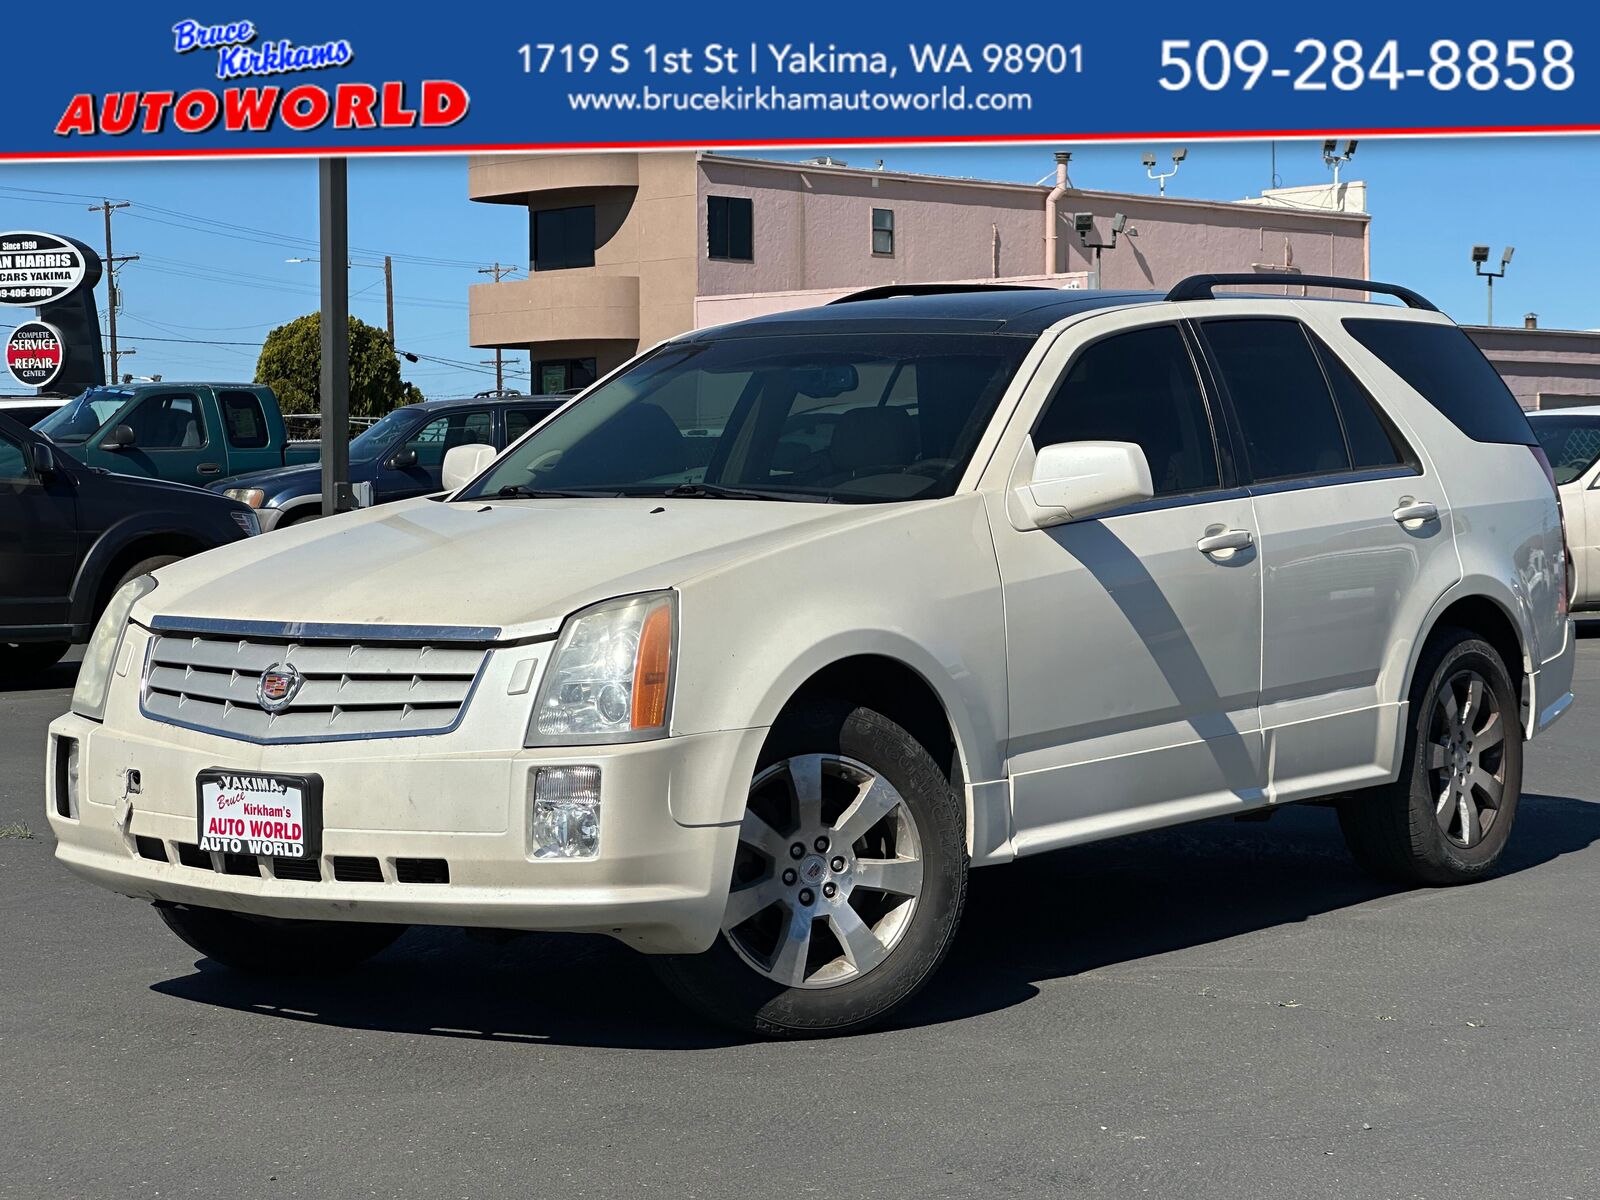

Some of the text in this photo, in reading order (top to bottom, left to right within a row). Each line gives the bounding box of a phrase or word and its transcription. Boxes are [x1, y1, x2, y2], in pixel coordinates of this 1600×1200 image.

[2, 241, 38, 250] Since 1990
[15, 253, 71, 268] HARRIS
[30, 271, 72, 281] YAKIMA
[0, 287, 53, 298] 9-406-0900
[17, 331, 50, 339] COMPLETE
[11, 338, 56, 351] SERVICE
[14, 357, 53, 369] REPAIR
[22, 370, 46, 378] CENTER
[221, 776, 281, 792] YAKIMA
[217, 792, 246, 810] Bruce
[243, 803, 292, 818] Kirkham's
[208, 817, 302, 841] AUTO WORLD
[199, 836, 304, 857] AUTO WORLD
